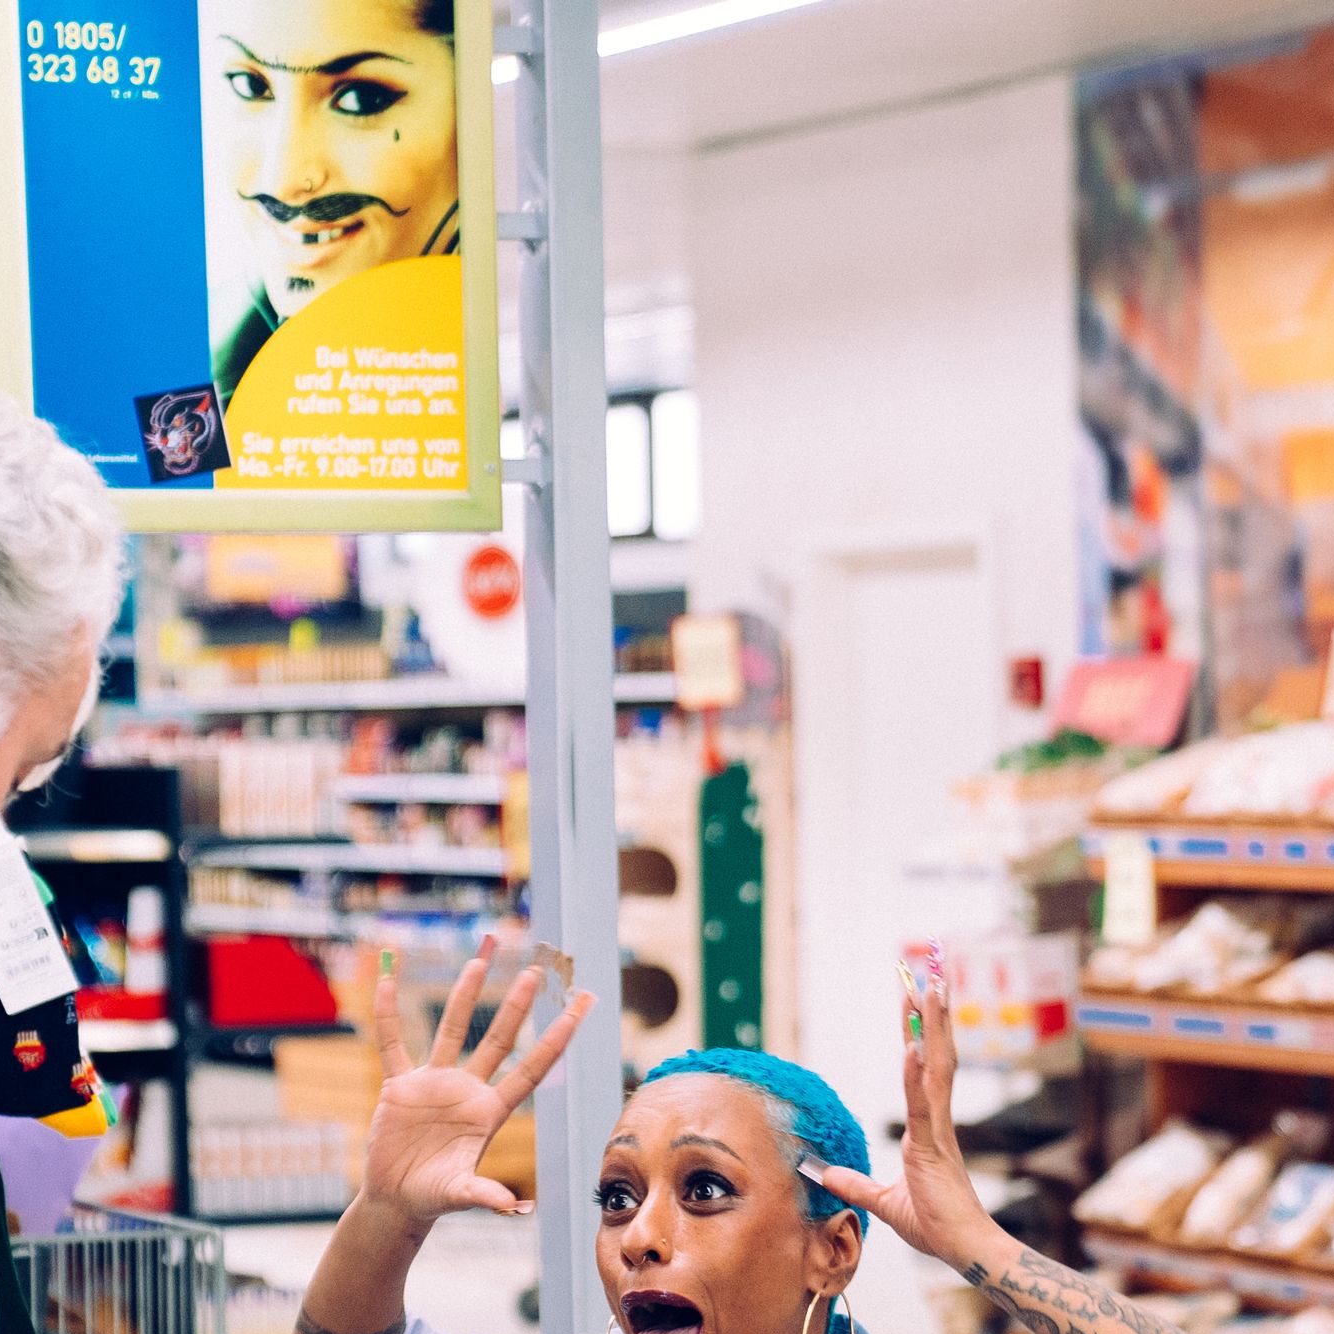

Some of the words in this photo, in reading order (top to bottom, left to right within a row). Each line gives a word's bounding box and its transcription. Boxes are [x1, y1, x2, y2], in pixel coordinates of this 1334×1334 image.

[27, 20, 44, 48] 0
[54, 21, 126, 51] 1805/
[27, 53, 77, 82] 323
[87, 56, 119, 84] 68
[129, 56, 161, 85] 37
[315, 346, 348, 368] Bei
[354, 347, 457, 369] Wünschen
[294, 370, 333, 391] und
[338, 371, 458, 396] Anregungen
[287, 393, 342, 414] rufen
[347, 394, 379, 415] Sie
[385, 398, 422, 415] uns
[428, 398, 457, 415] an.
[241, 432, 274, 454] Sie
[280, 434, 375, 454] erreichen
[381, 439, 419, 454] uns
[424, 439, 459, 455] von
[422, 458, 459, 478] Uhr
